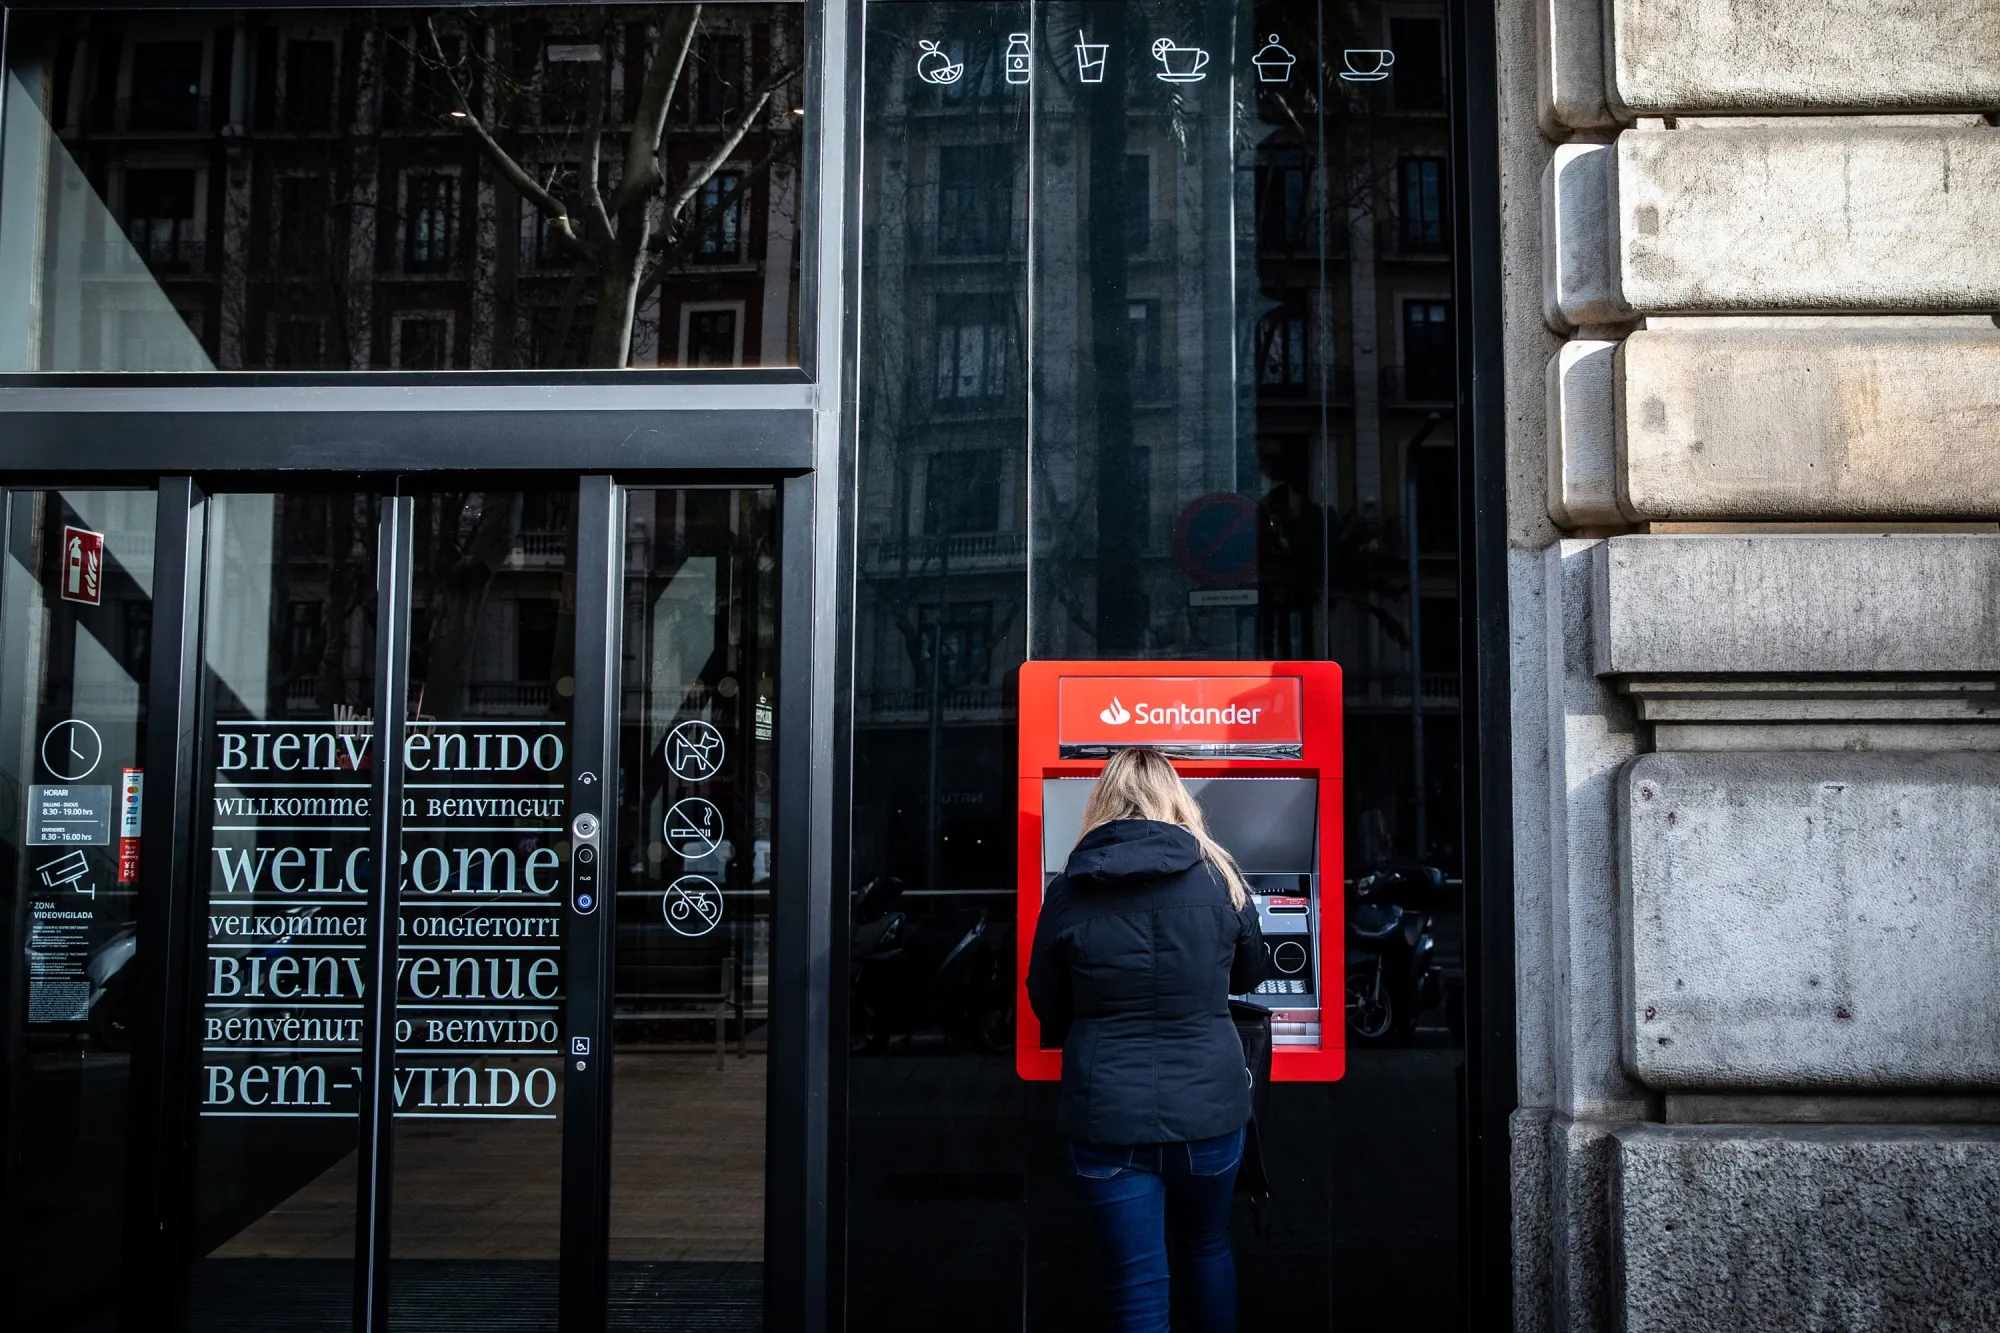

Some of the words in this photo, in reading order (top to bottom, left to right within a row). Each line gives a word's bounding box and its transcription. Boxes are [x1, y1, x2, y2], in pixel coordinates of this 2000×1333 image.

[1134, 702, 1261, 726] Santander
[41, 833, 57, 841] 8.30
[62, 833, 81, 841] 16.00
[81, 833, 92, 841] hrs
